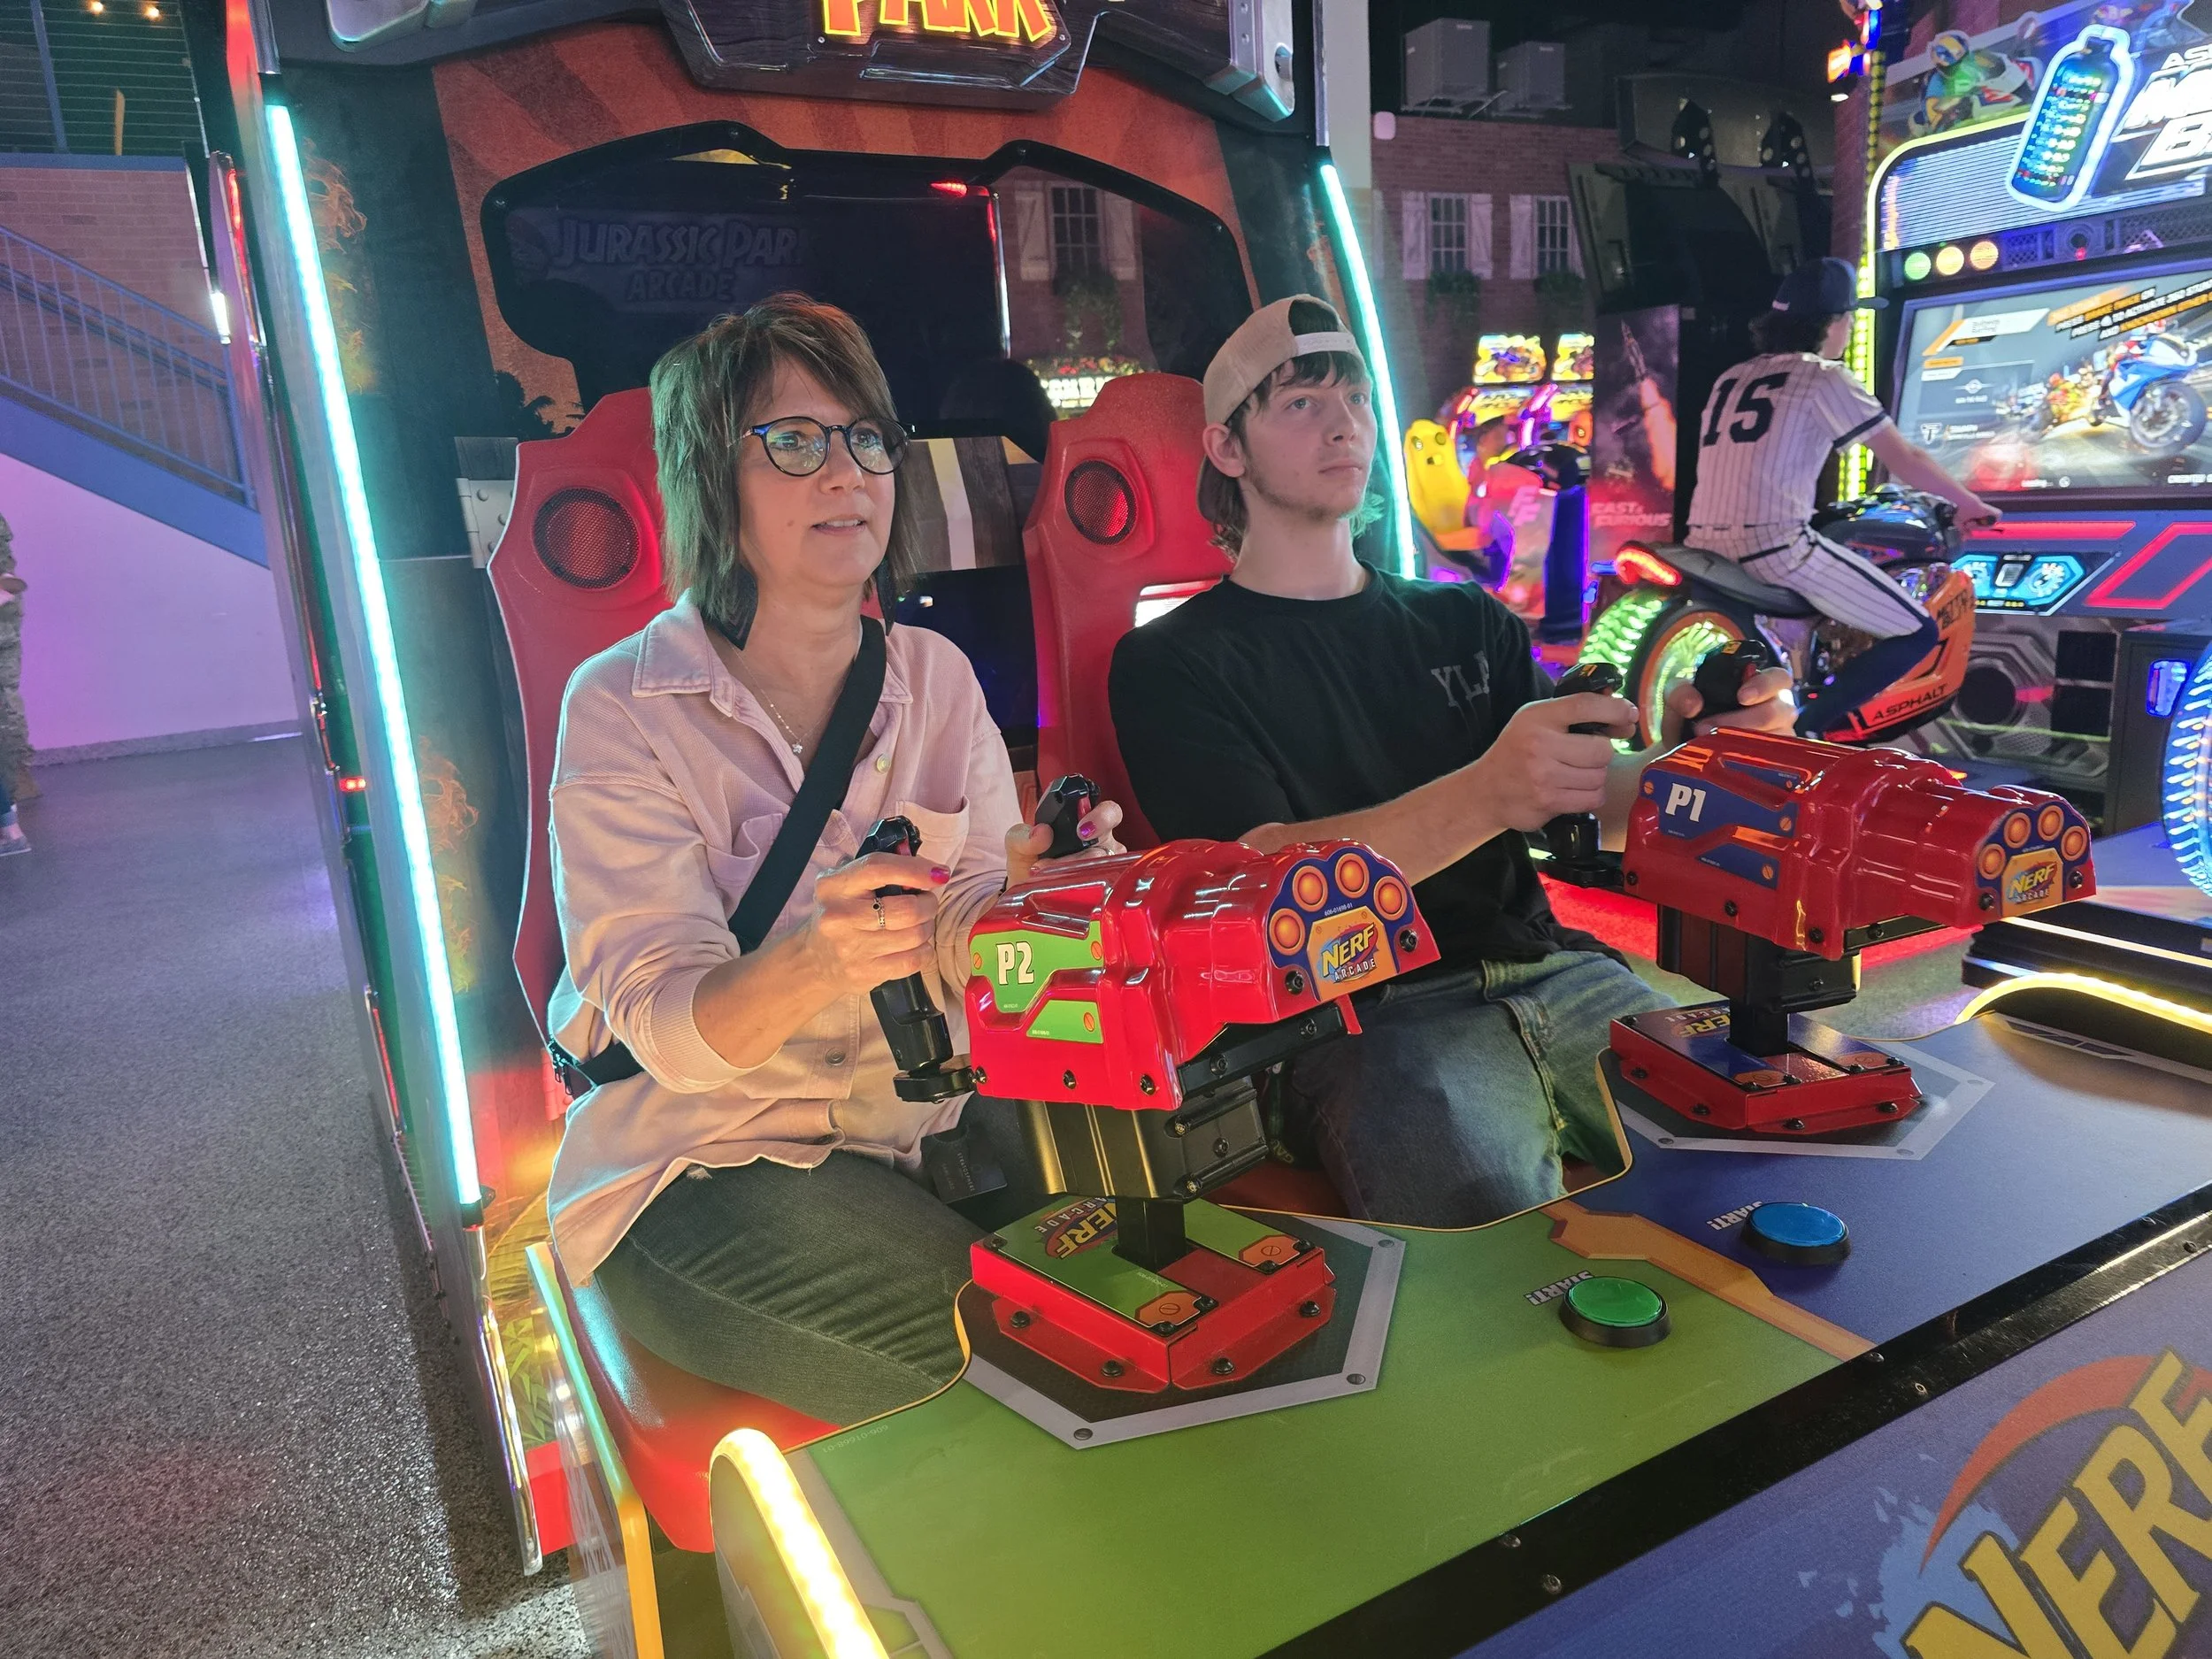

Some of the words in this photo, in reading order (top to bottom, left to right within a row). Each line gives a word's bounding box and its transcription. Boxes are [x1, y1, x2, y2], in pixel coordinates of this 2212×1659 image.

[549, 220, 721, 265] JURASSIC
[723, 219, 809, 267] PAR
[626, 268, 734, 302] ARCADE
[1702, 372, 1791, 446] 15
[1871, 684, 1947, 722] ASPHALT
[1664, 782, 1707, 823] P1
[2008, 862, 2057, 898] NERF
[995, 941, 1035, 986] P2
[1322, 922, 1376, 978] NERF
[1334, 958, 1377, 981] ARCADE
[1678, 1013, 1732, 1038] ERF
[1034, 1196, 1107, 1234] ARCADE
